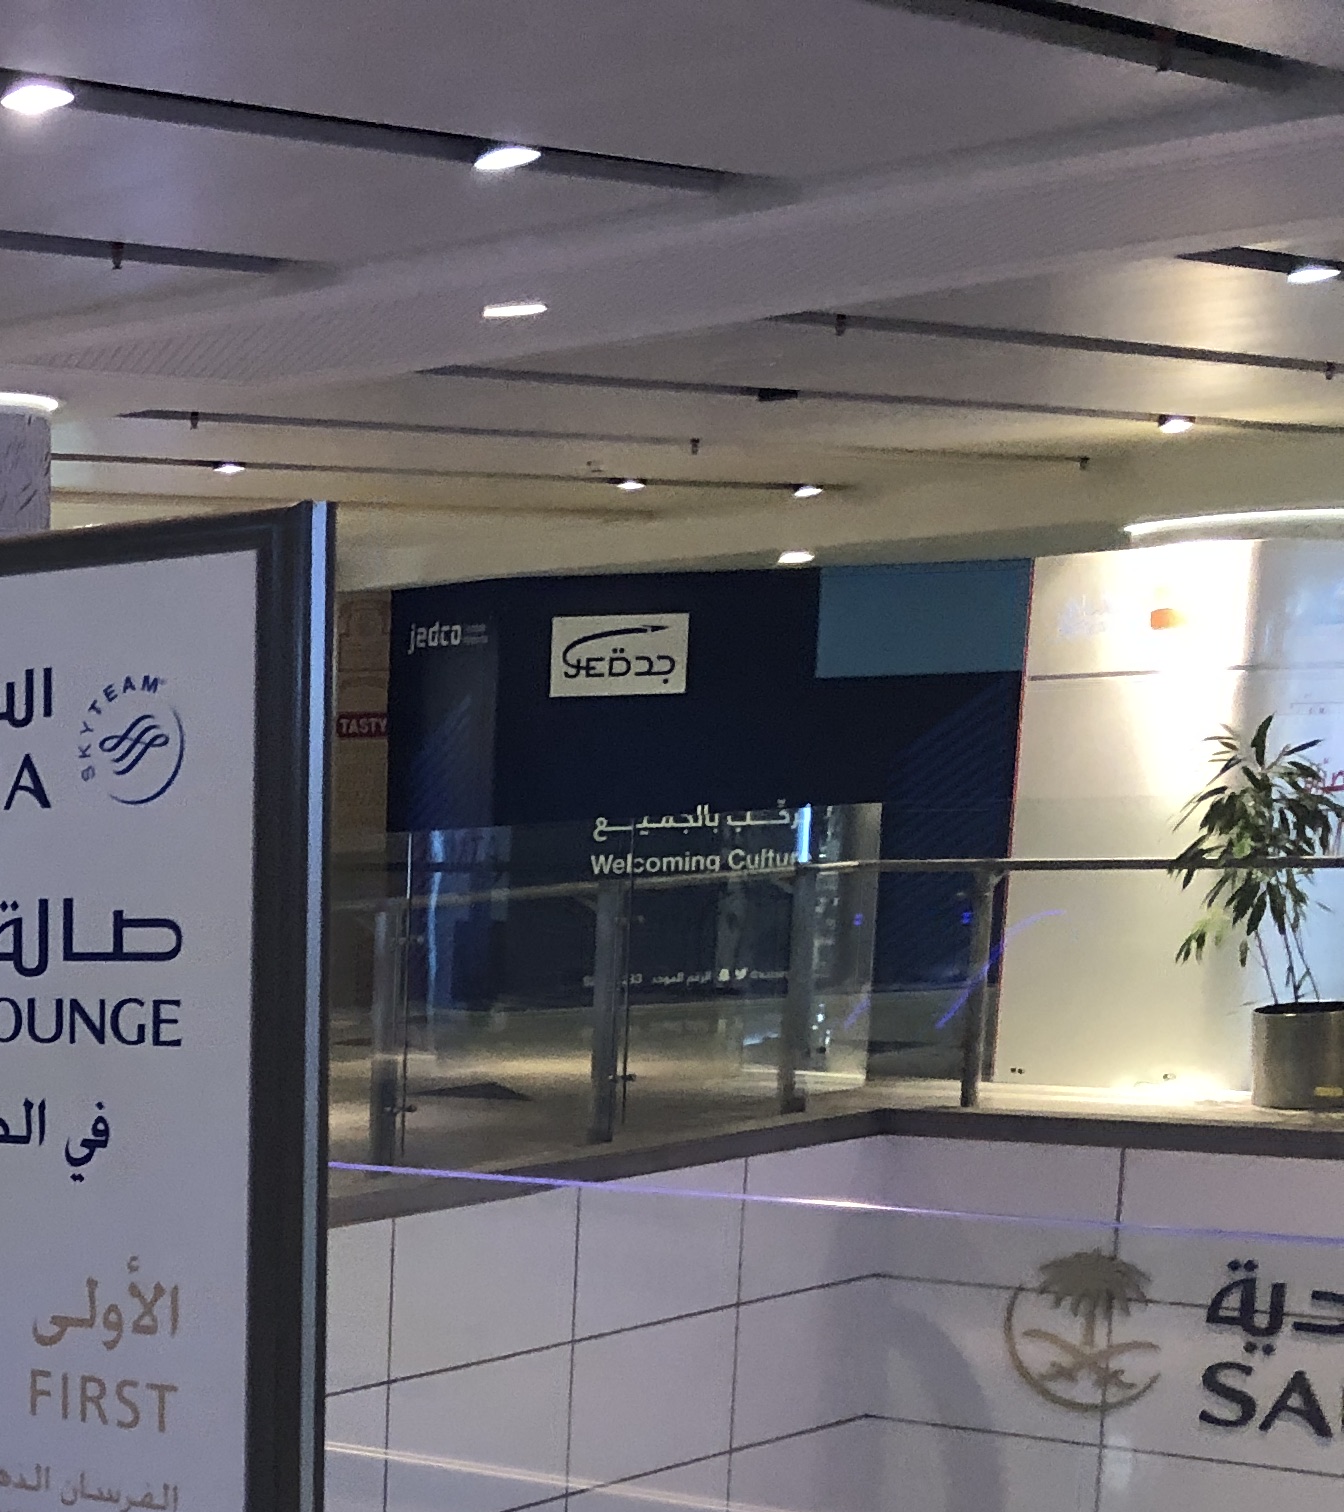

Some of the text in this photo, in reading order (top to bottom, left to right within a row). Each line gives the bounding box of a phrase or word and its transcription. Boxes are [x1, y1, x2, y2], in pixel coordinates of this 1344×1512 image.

[407, 621, 461, 655] jedco
[78, 674, 162, 782] SKYTEAM
[338, 718, 388, 735] TASTY
[590, 852, 721, 876] Welcoming
[64, 1101, 111, 1184] في
[31, 1255, 180, 1351] الأولى
[29, 1368, 180, 1433] FIRST
[1199, 1361, 1344, 1438] SA
